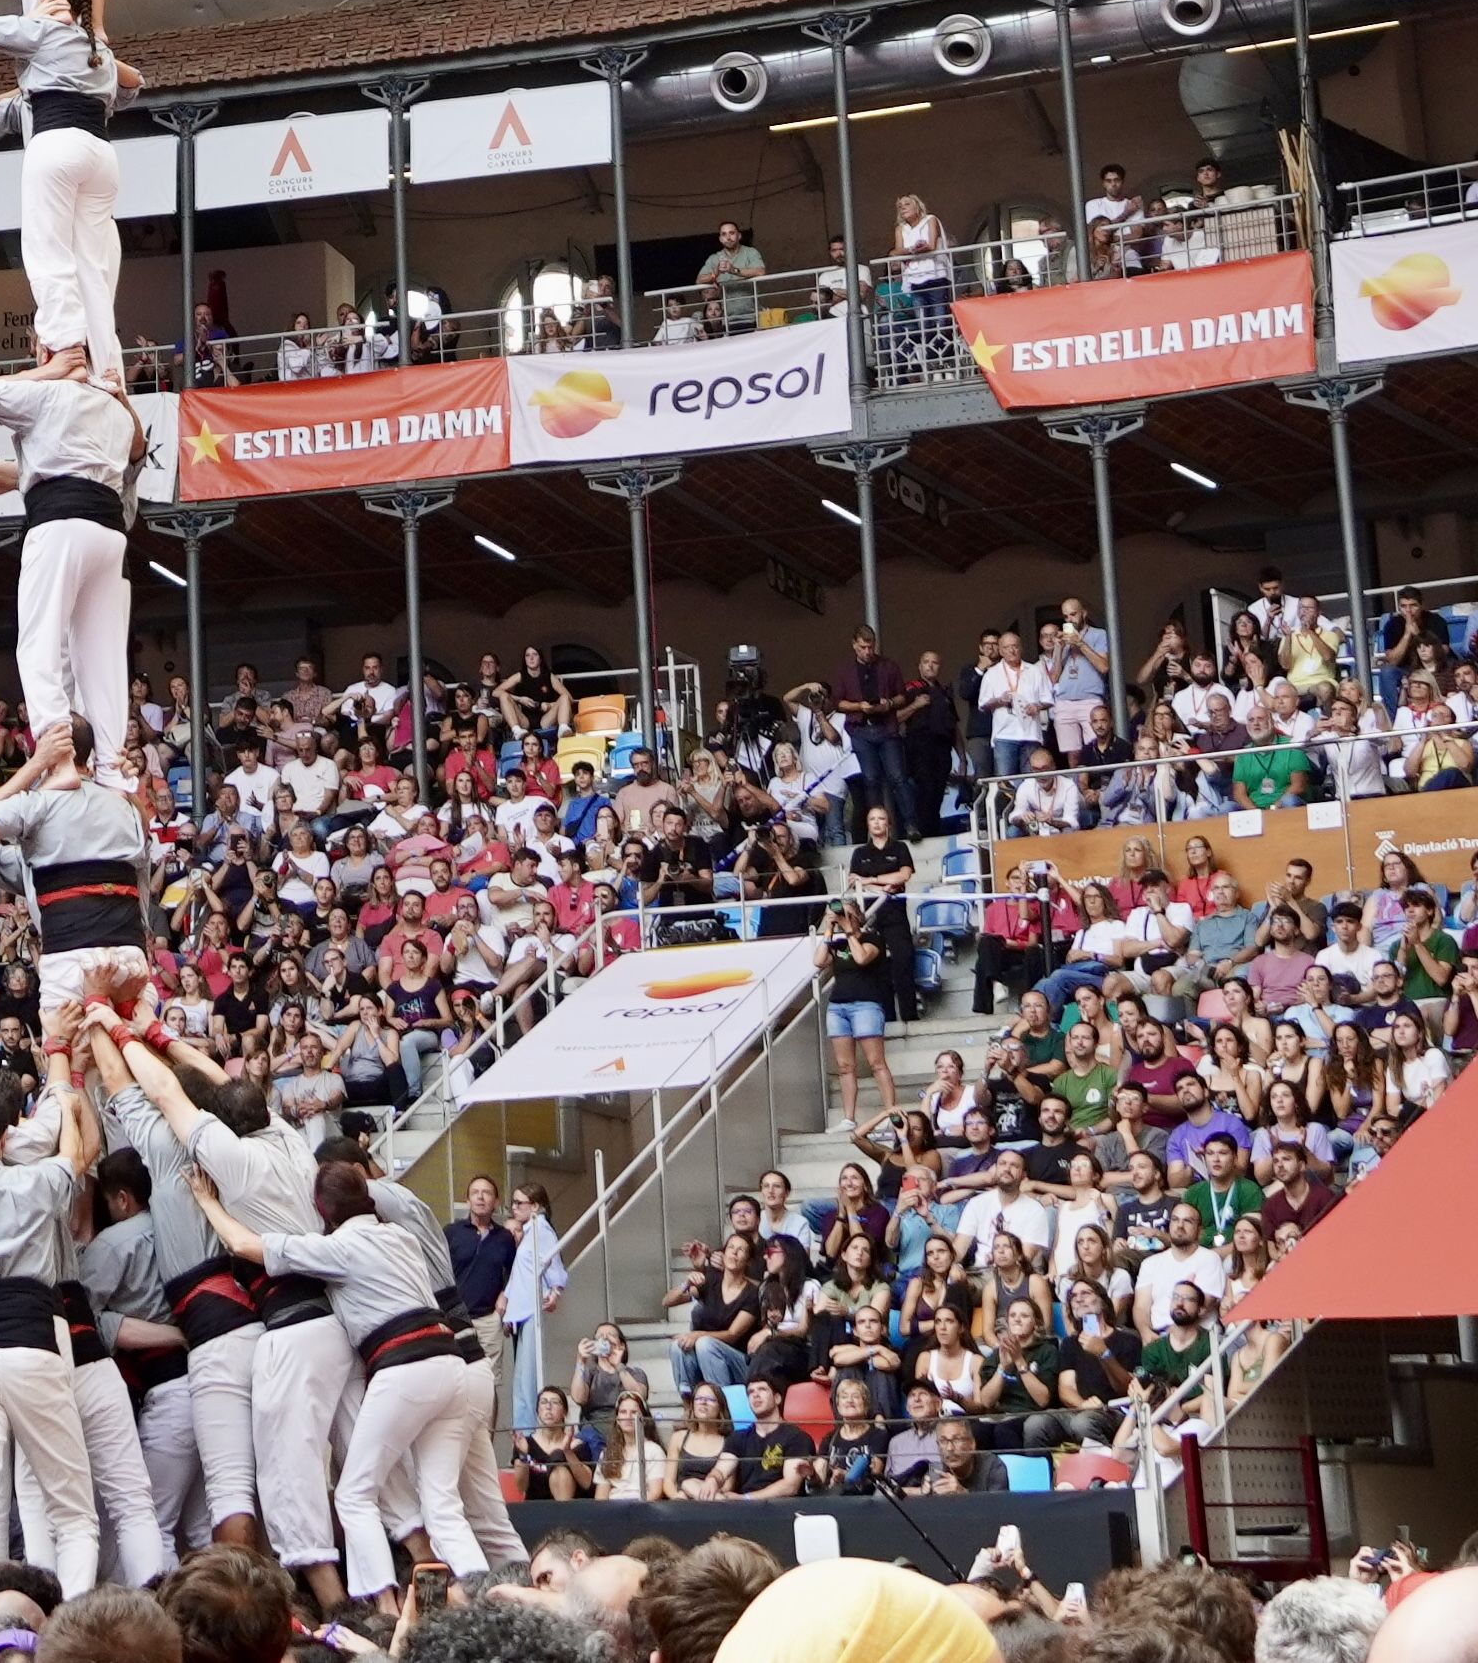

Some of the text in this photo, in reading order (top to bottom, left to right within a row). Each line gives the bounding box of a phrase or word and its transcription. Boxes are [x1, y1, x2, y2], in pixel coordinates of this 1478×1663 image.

[1010, 303, 1305, 372] ESTRELLA DAMM
[648, 353, 825, 420] repsol
[232, 404, 504, 461] ESTRELLA DAMM
[1403, 839, 1457, 857] Diputació
[604, 998, 739, 1019] repsol
